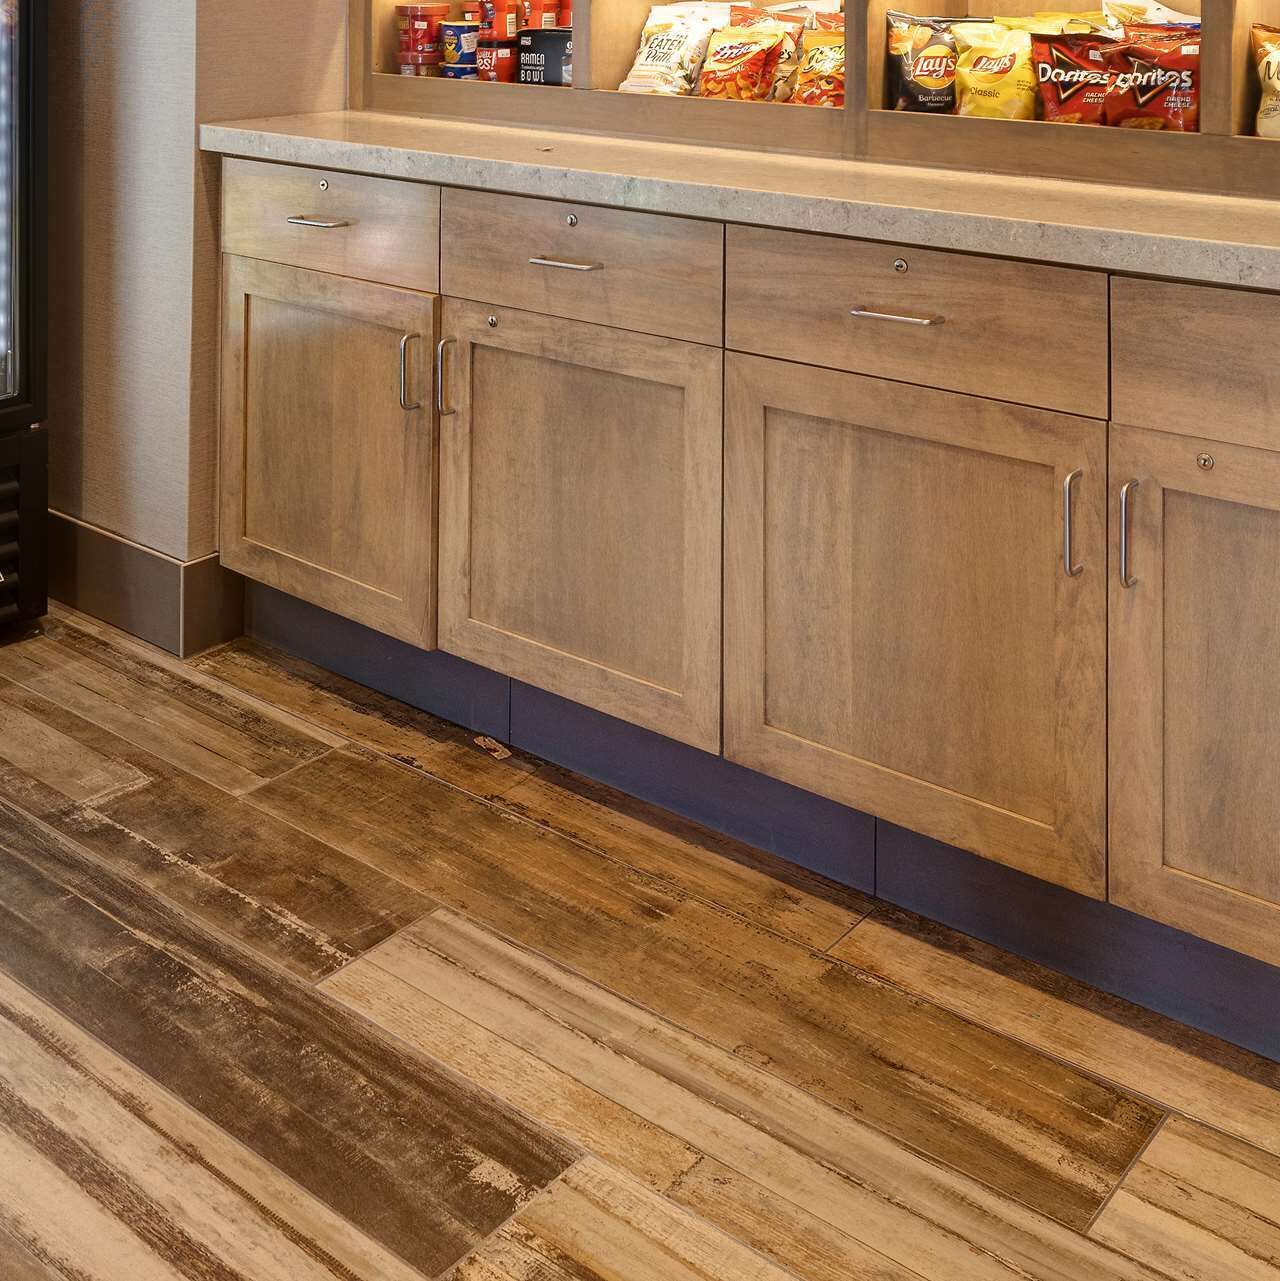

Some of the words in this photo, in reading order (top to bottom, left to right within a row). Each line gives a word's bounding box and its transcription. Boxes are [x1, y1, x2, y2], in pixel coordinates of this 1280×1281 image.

[649, 37, 685, 50] EATEN
[521, 53, 545, 65] RAMEN
[973, 52, 1016, 74] Lay's
[914, 54, 956, 78] Lay's
[521, 70, 545, 82] BOWL
[1038, 63, 1109, 83] Doritos
[918, 93, 953, 103] Barbecue
[970, 87, 1001, 99] Classic
